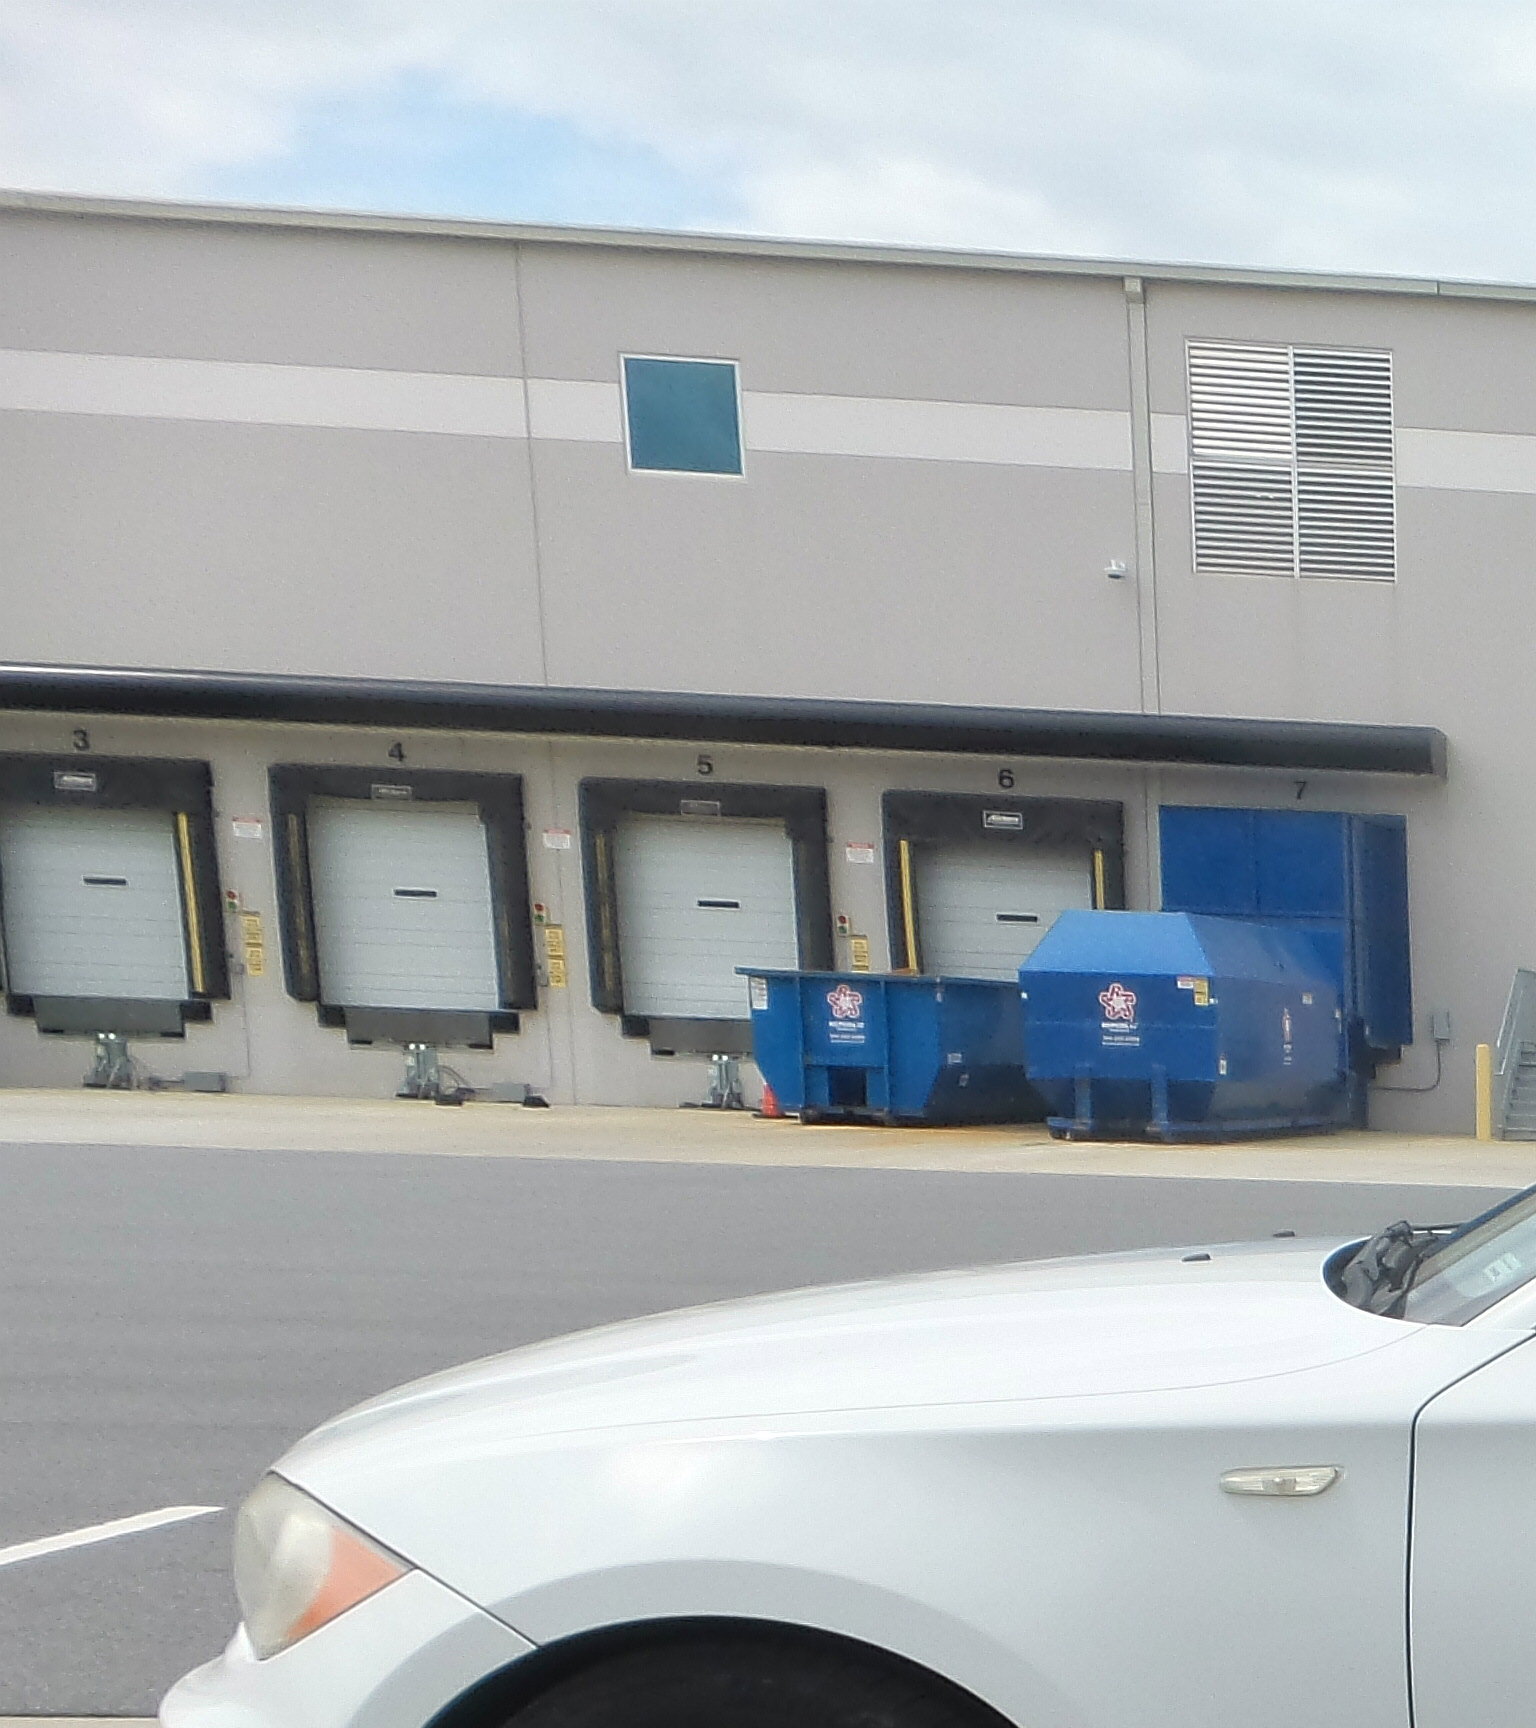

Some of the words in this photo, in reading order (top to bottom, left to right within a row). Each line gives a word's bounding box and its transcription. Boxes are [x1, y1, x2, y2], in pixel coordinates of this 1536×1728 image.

[73, 729, 90, 752] 3
[388, 741, 407, 762] 4
[697, 754, 713, 776] 5
[999, 768, 1015, 788] 6
[1293, 780, 1307, 801] 7
